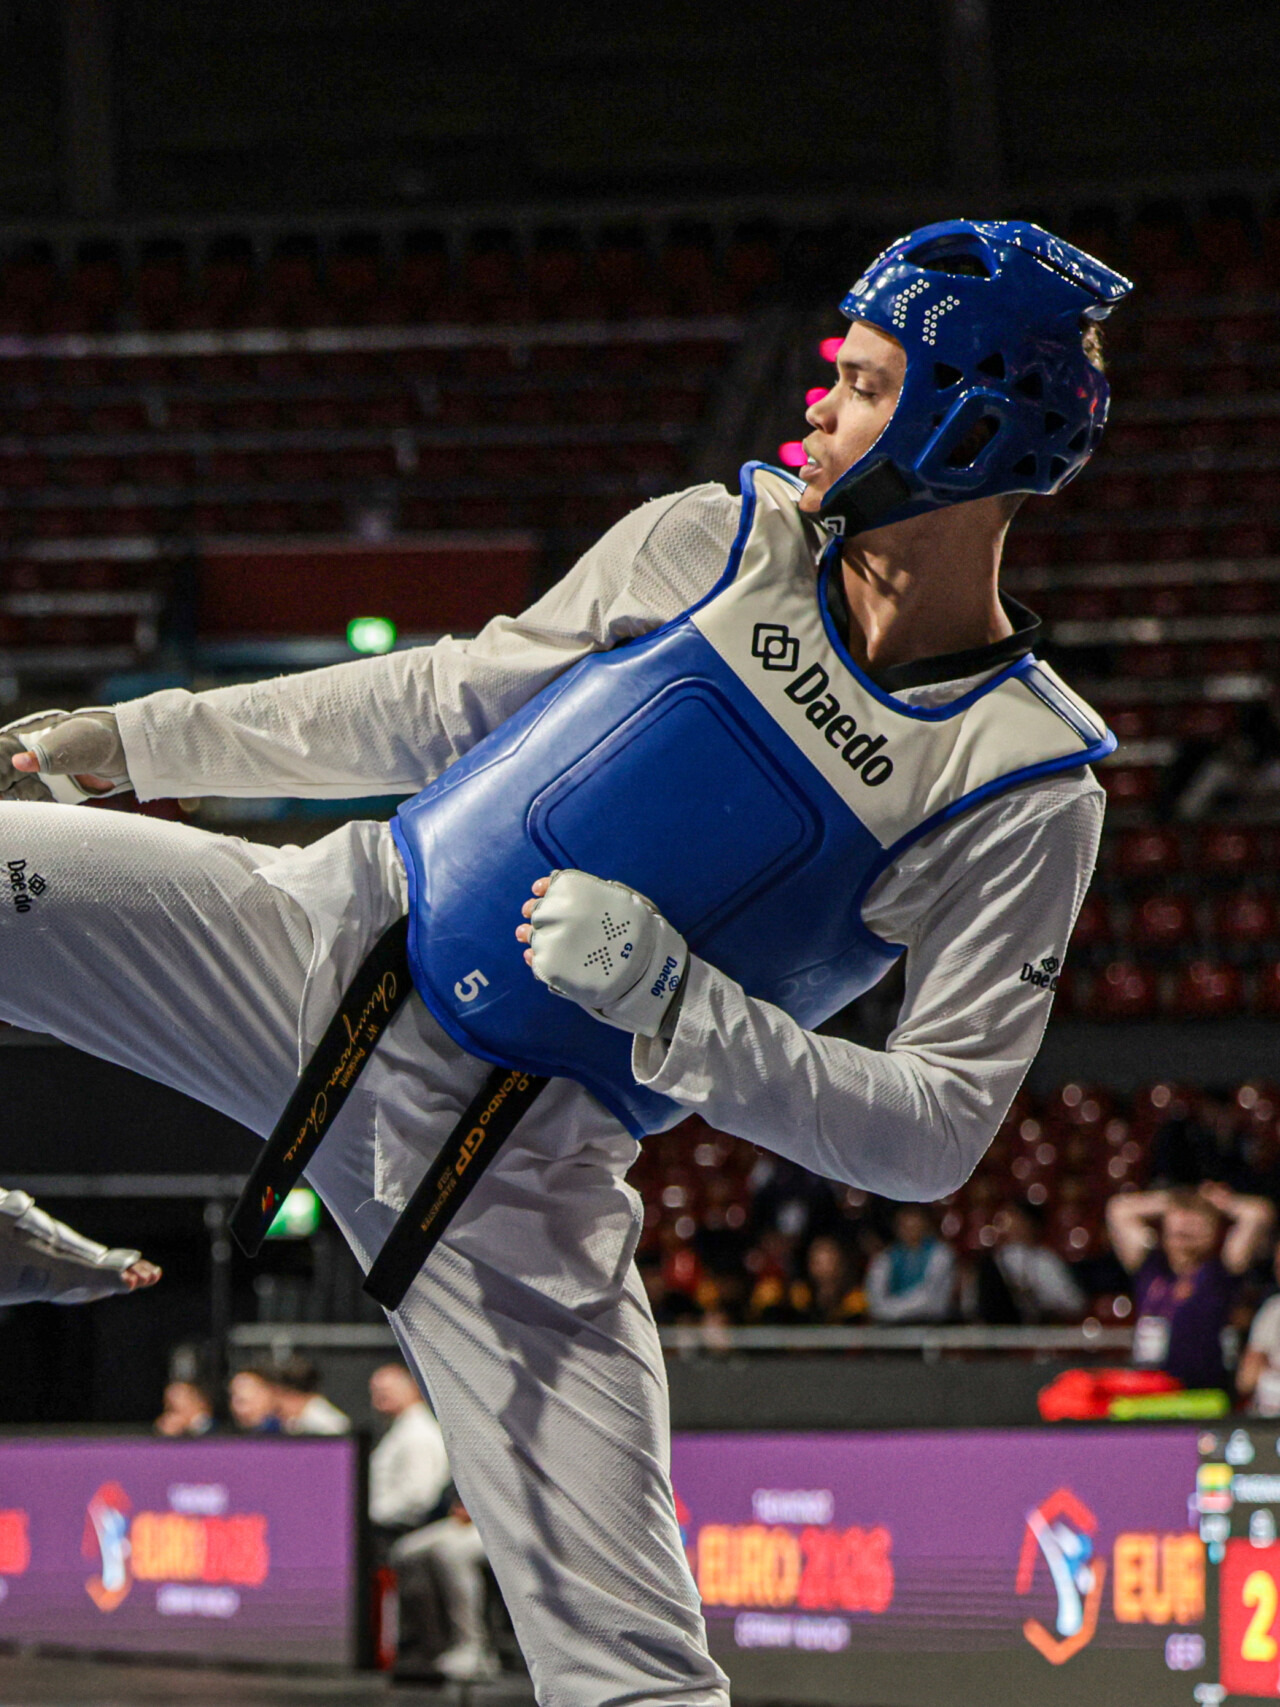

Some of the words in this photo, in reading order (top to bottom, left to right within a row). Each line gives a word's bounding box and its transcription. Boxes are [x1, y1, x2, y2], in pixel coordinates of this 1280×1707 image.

[783, 661, 894, 787] Daedo
[7, 859, 32, 914] Daedo
[620, 942, 633, 960] G3
[454, 969, 489, 1002] 5
[650, 955, 678, 998] Daedo
[455, 1127, 486, 1176] GP
